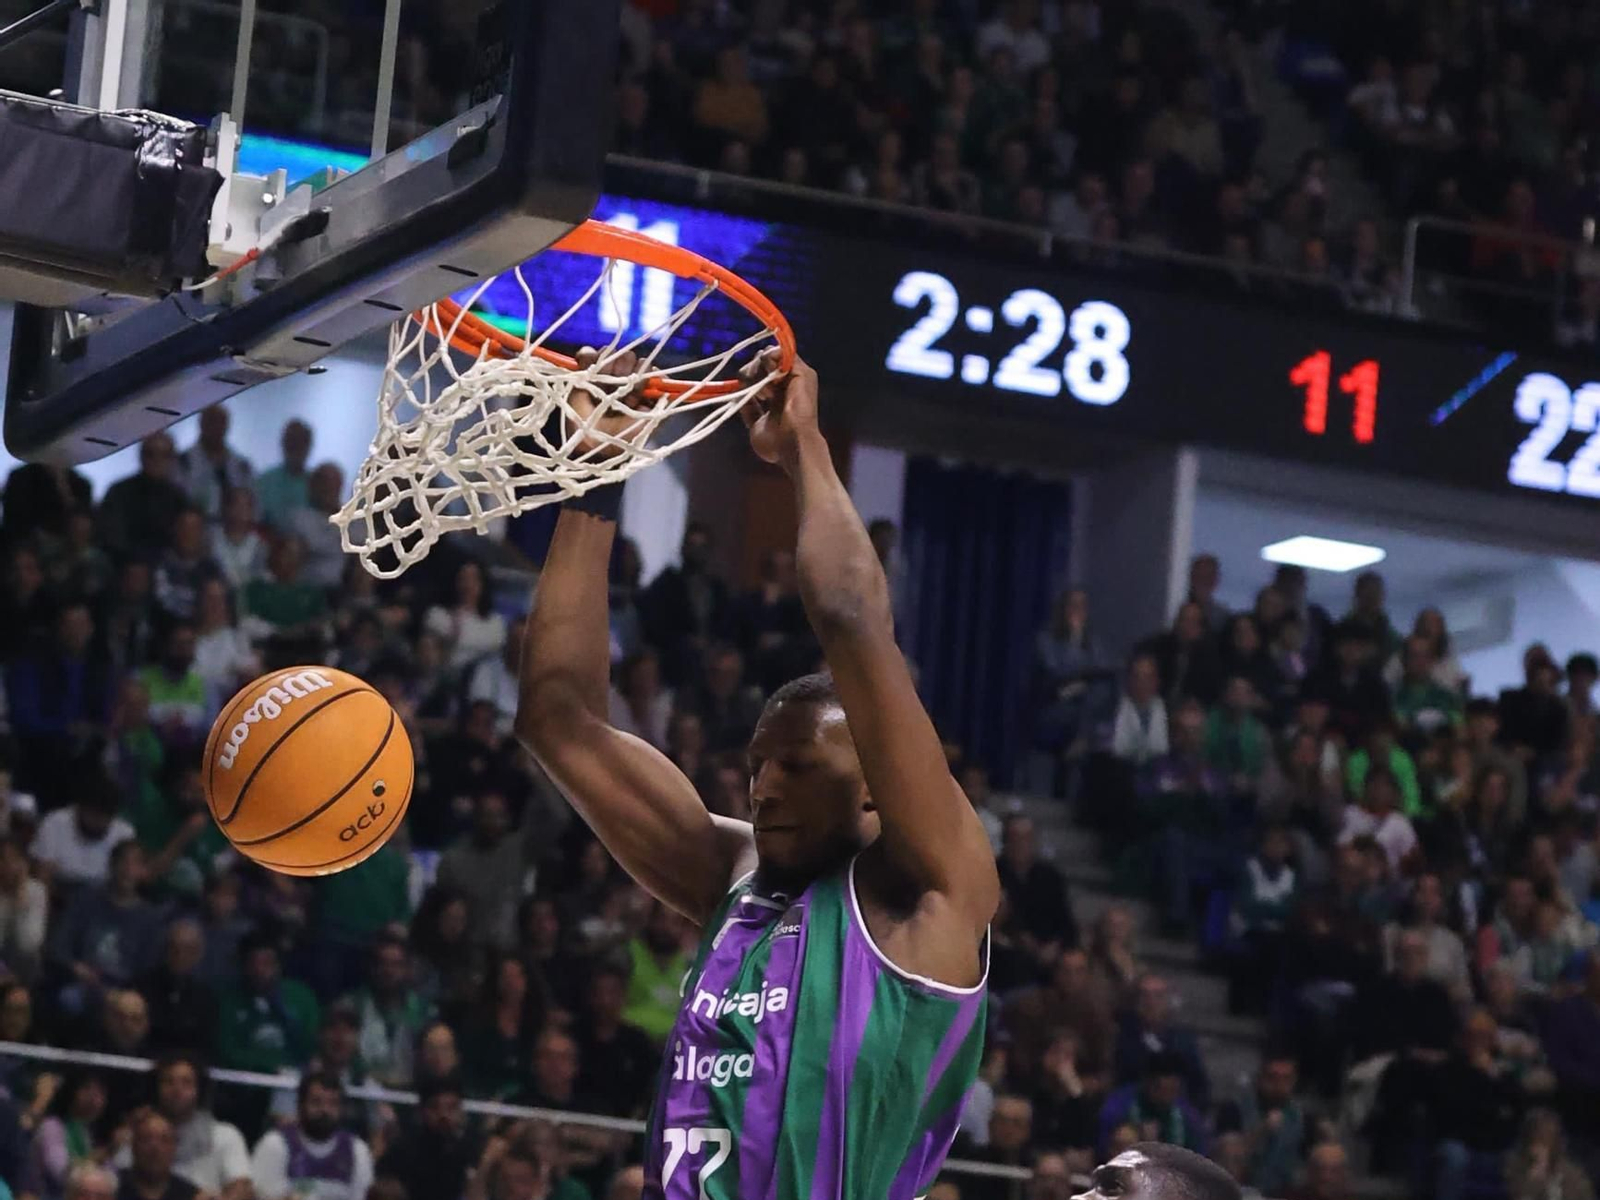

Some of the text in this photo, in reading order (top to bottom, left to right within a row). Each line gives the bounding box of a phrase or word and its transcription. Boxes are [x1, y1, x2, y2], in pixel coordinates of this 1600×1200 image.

[600, 213, 680, 339] 11
[886, 271, 1131, 406] 2:28
[1289, 350, 1380, 444] 11
[219, 670, 334, 770] Wilson
[672, 1040, 756, 1087] álaga
